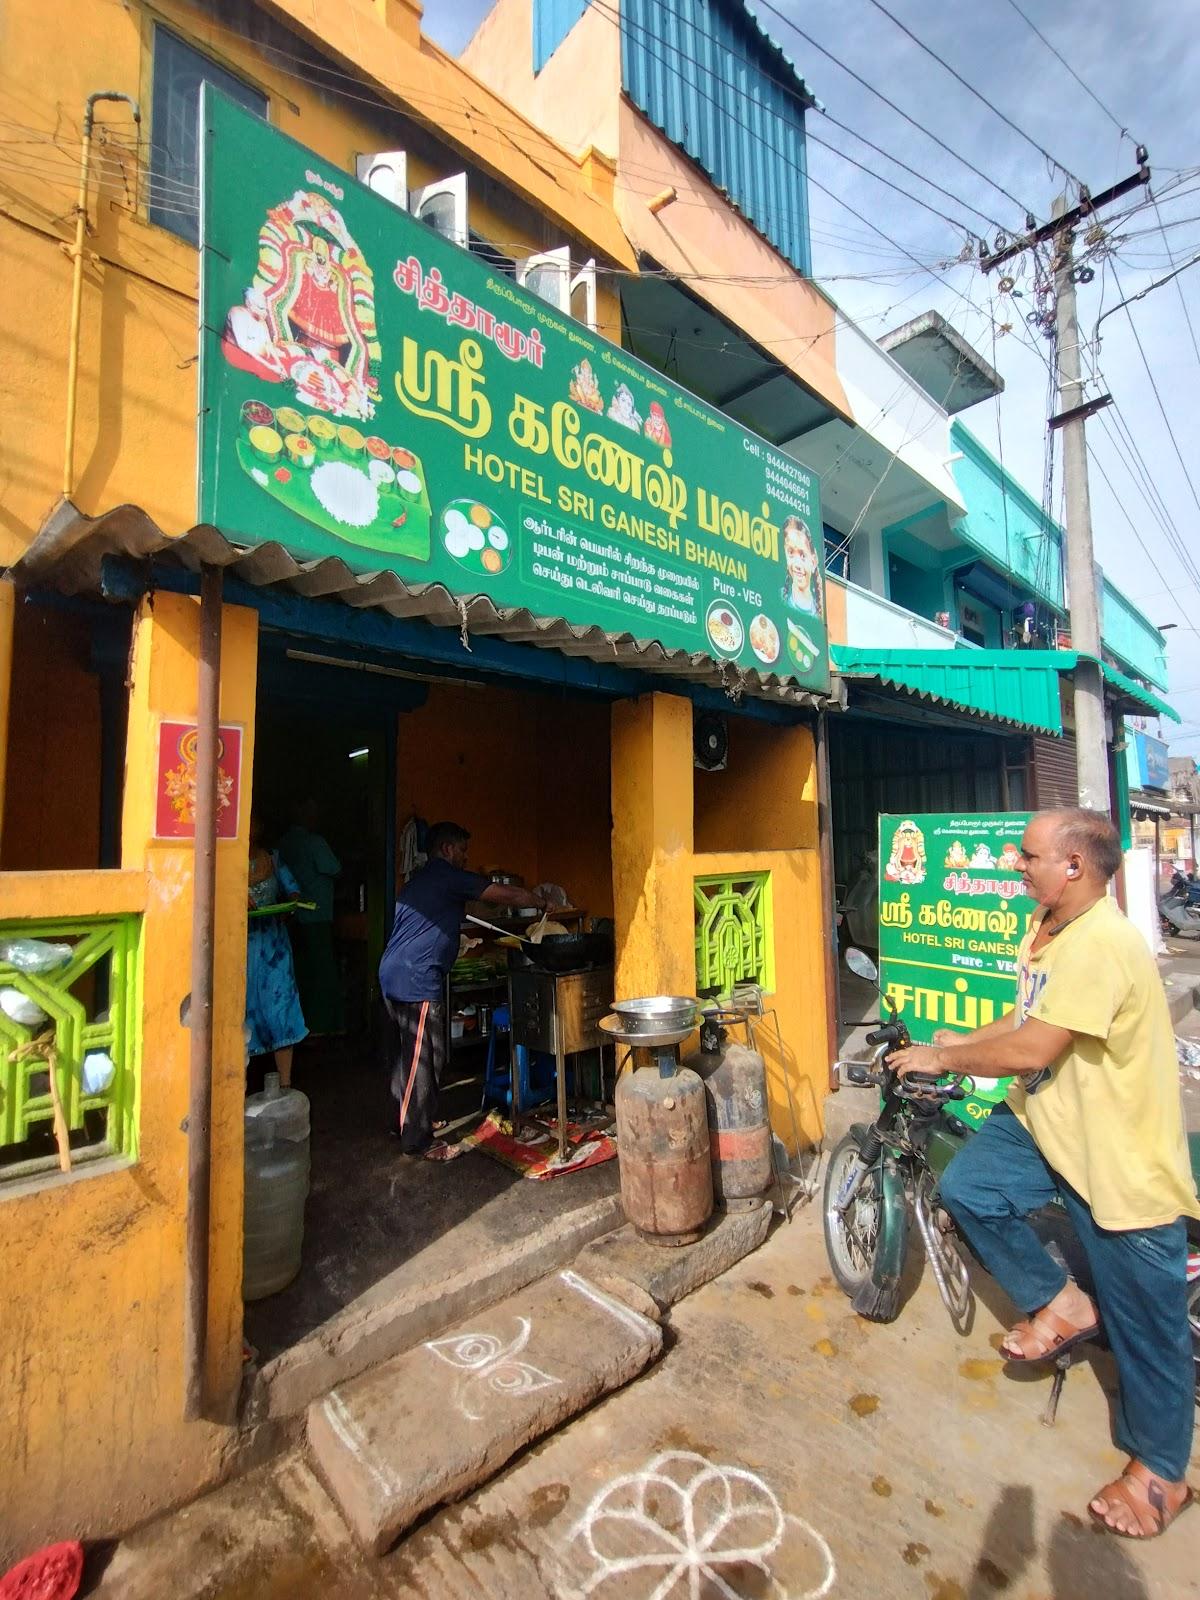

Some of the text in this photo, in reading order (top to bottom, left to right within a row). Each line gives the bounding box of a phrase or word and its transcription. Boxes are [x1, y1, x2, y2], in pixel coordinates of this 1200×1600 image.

[393, 255, 546, 370] சித்தாமூர்
[394, 335, 780, 563] ஸ்ரீ கணேஷ் பவன்
[743, 438, 760, 457] Cell
[464, 442, 748, 582] HOTEL SRI GANESH BHAVAN
[523, 517, 700, 590] ஆர்டரின் பெயரில் சிறந்த முறையில்
[533, 542, 694, 606] டிபன் மற்றும் சாப்பாடு வகைகள்
[533, 562, 698, 625] செய்து டெலிவரி செய்து தரப்படும்
[713, 576, 736, 599] Pure
[743, 588, 763, 607] VEG
[880, 892, 913, 929] ஸ்ரீ
[918, 900, 1018, 941] கணேஷ்
[903, 932, 942, 947] HOTEL
[944, 936, 965, 950] SRI
[952, 953, 983, 968] Pure
